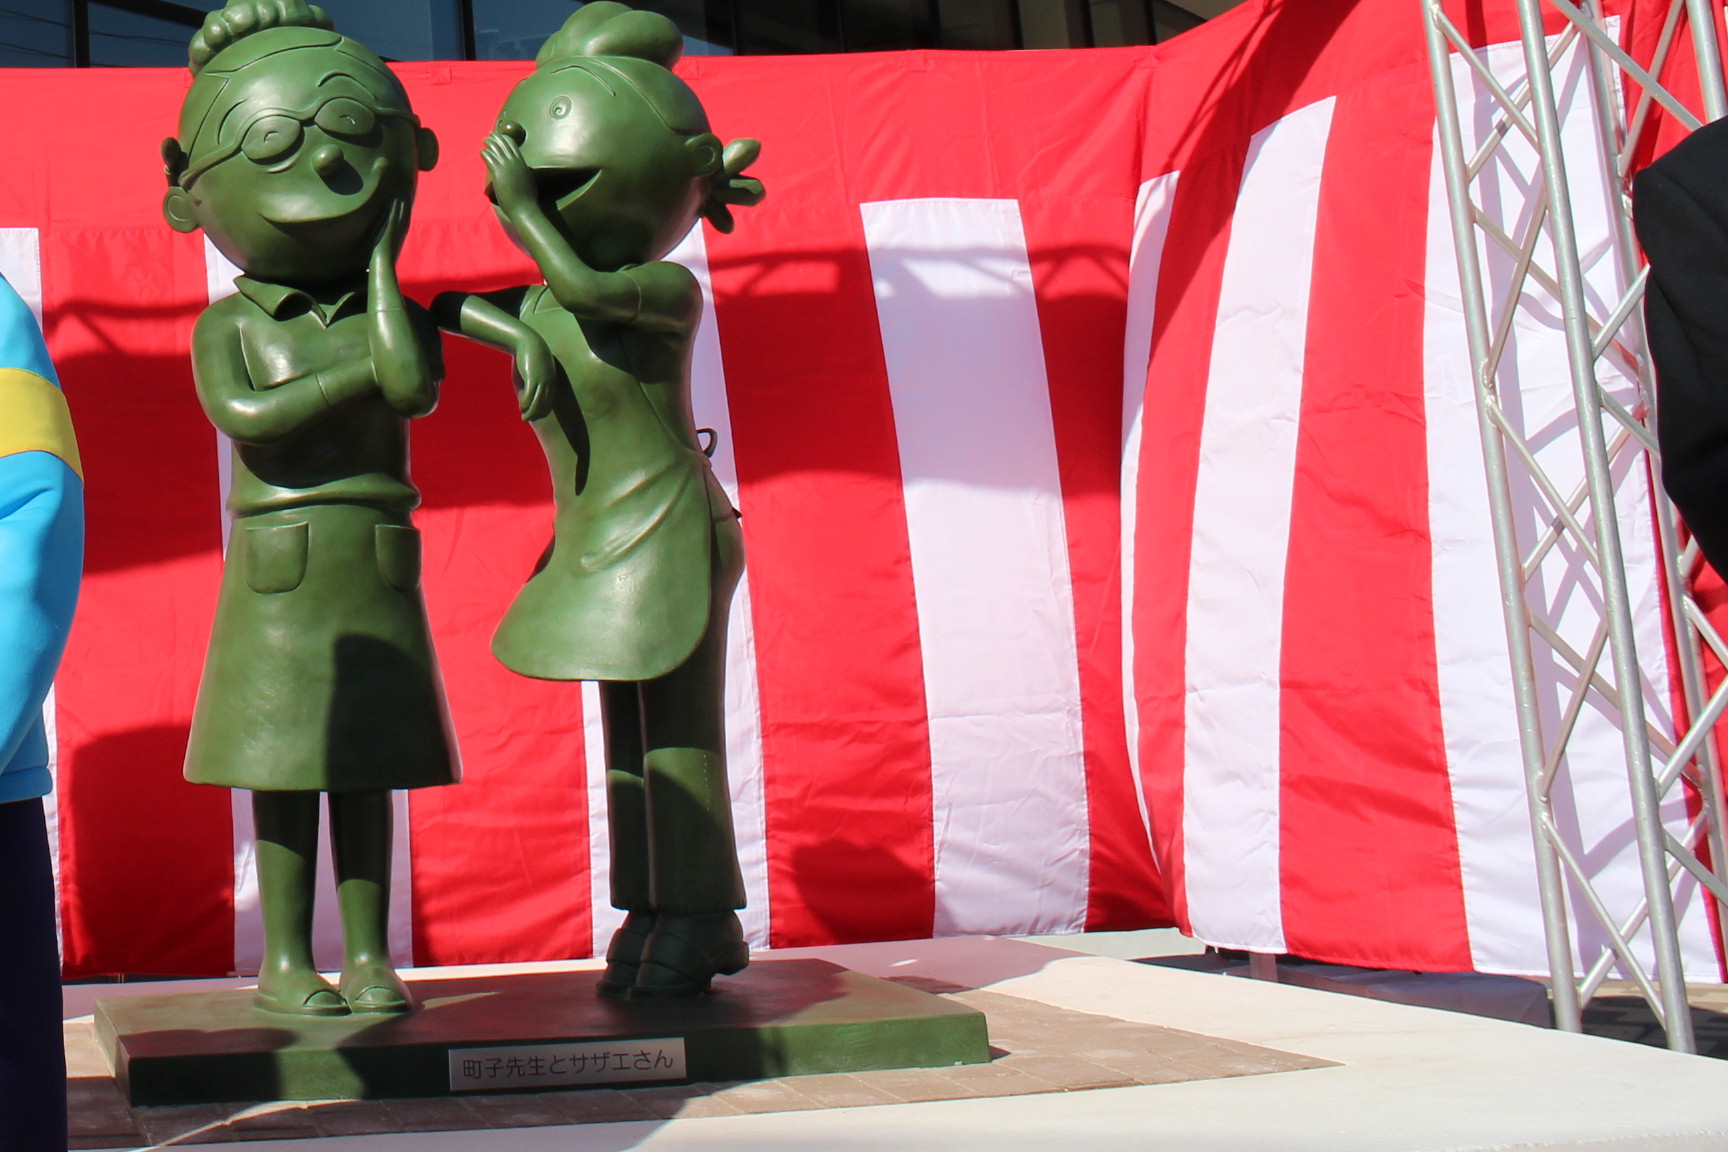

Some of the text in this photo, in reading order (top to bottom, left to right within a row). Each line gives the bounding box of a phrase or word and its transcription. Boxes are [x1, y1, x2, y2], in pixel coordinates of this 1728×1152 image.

[463, 1049, 674, 1079] 町子先生とサザエさん
